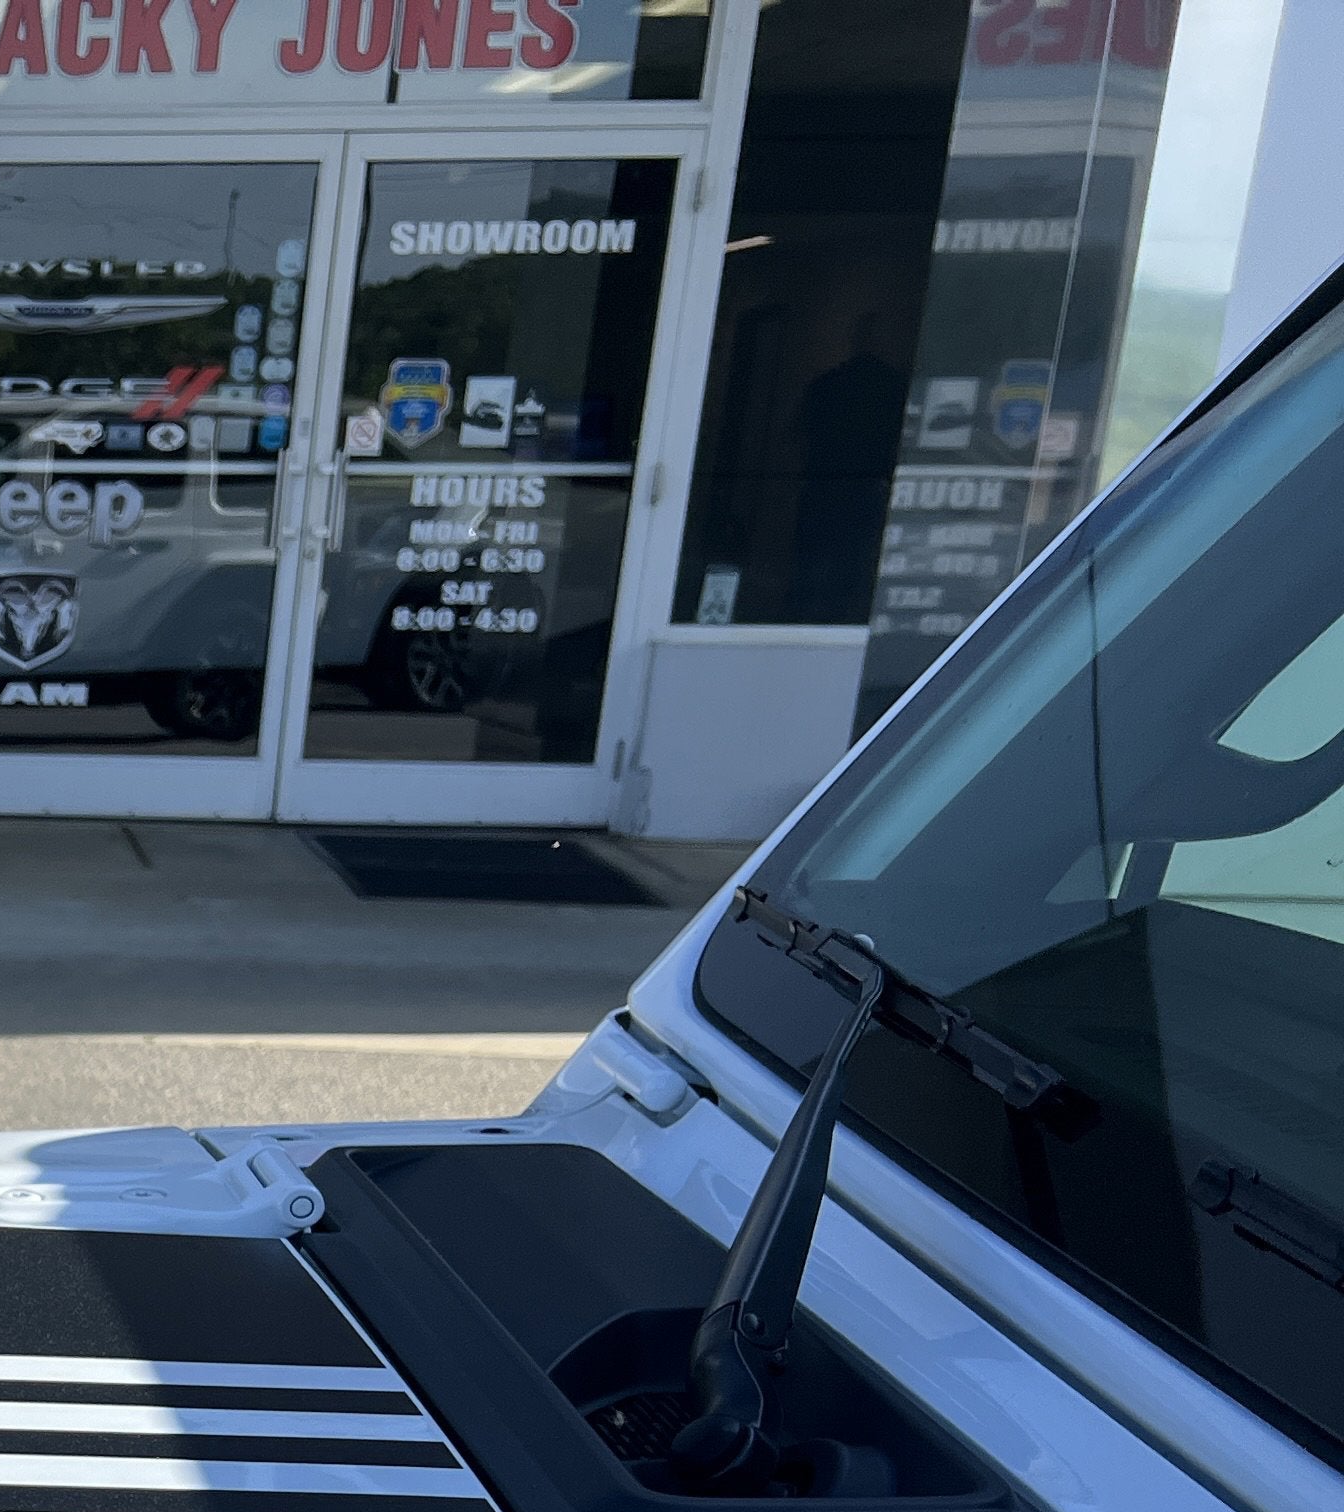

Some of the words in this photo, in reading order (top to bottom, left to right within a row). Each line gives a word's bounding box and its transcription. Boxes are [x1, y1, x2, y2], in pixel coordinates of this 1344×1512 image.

[279, 0, 578, 73] JONES
[390, 219, 637, 256] SHOWROOM
[411, 475, 547, 508] HOURS
[441, 580, 494, 606] SAT
[474, 607, 538, 633] 4:30
